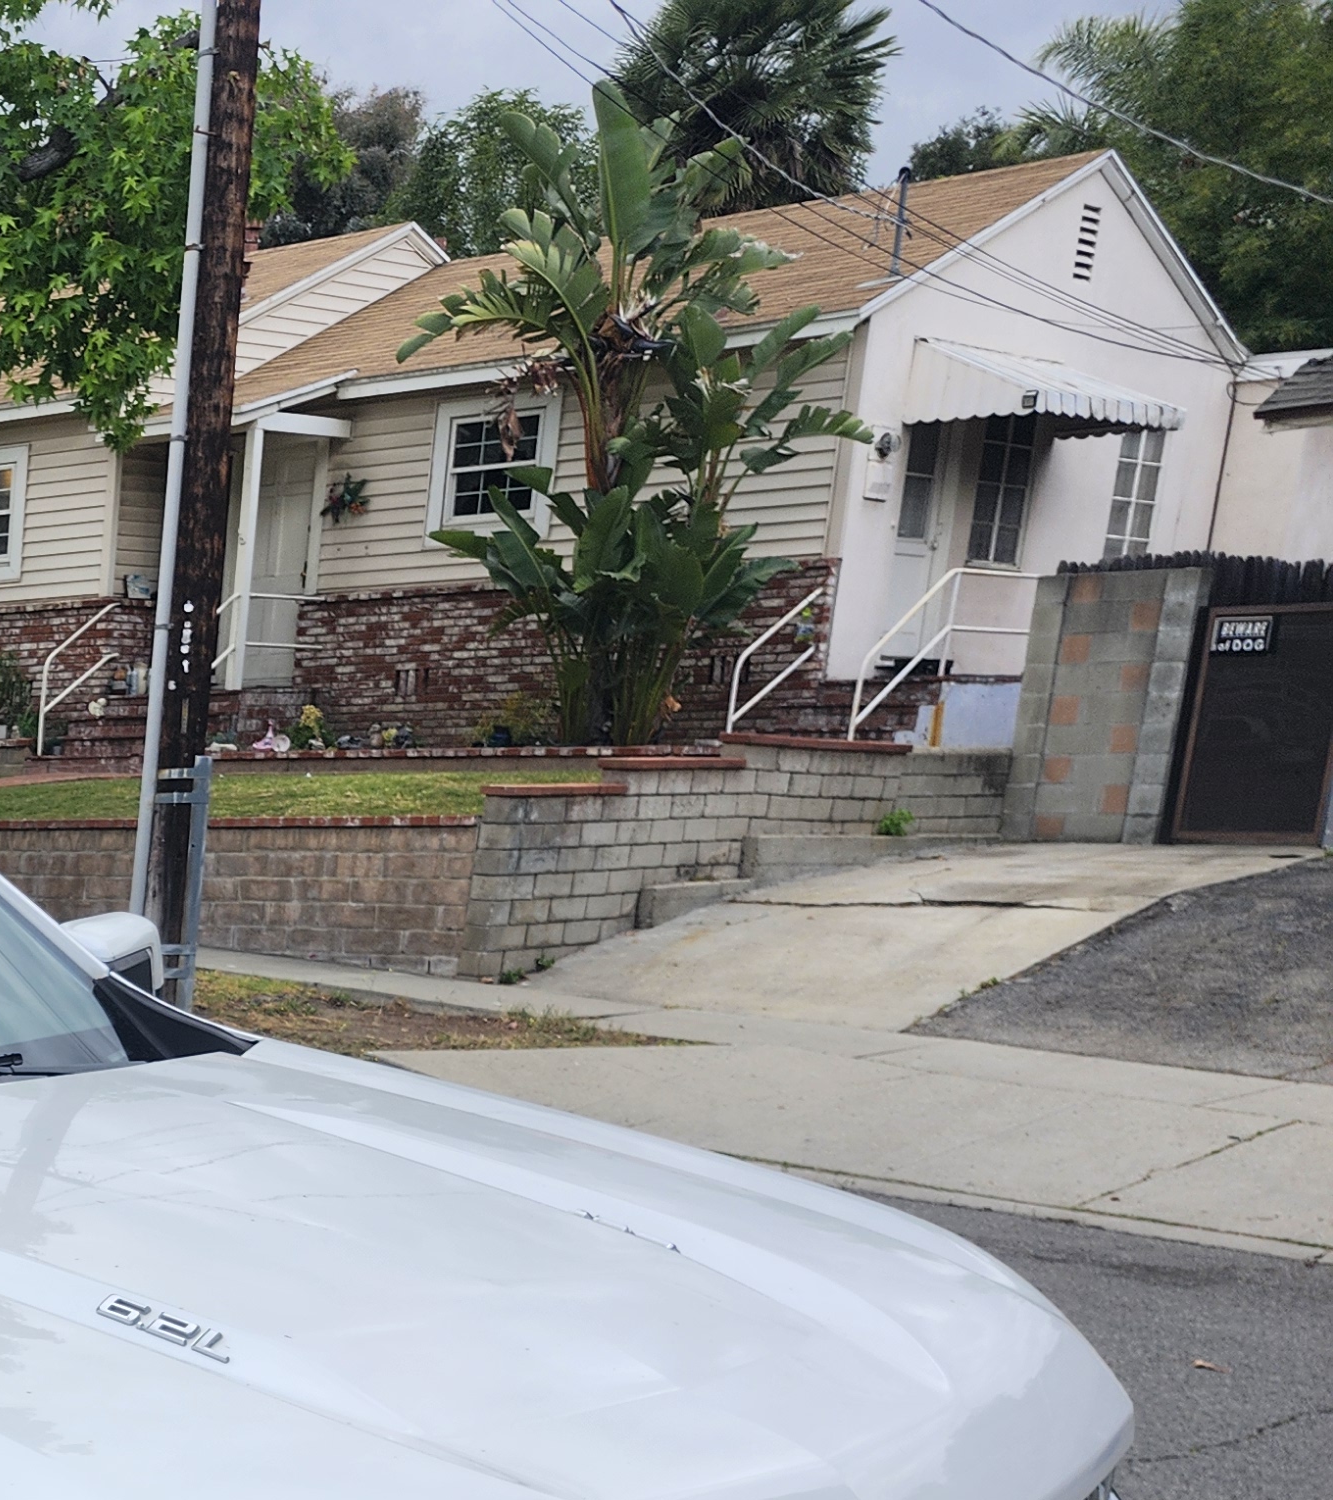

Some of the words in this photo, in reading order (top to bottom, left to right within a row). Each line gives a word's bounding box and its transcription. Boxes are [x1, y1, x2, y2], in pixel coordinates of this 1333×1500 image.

[1220, 621, 1268, 637] BEWARE
[1217, 640, 1231, 651] of
[1232, 639, 1265, 651] DOG
[95, 1293, 231, 1364] 6.2L
